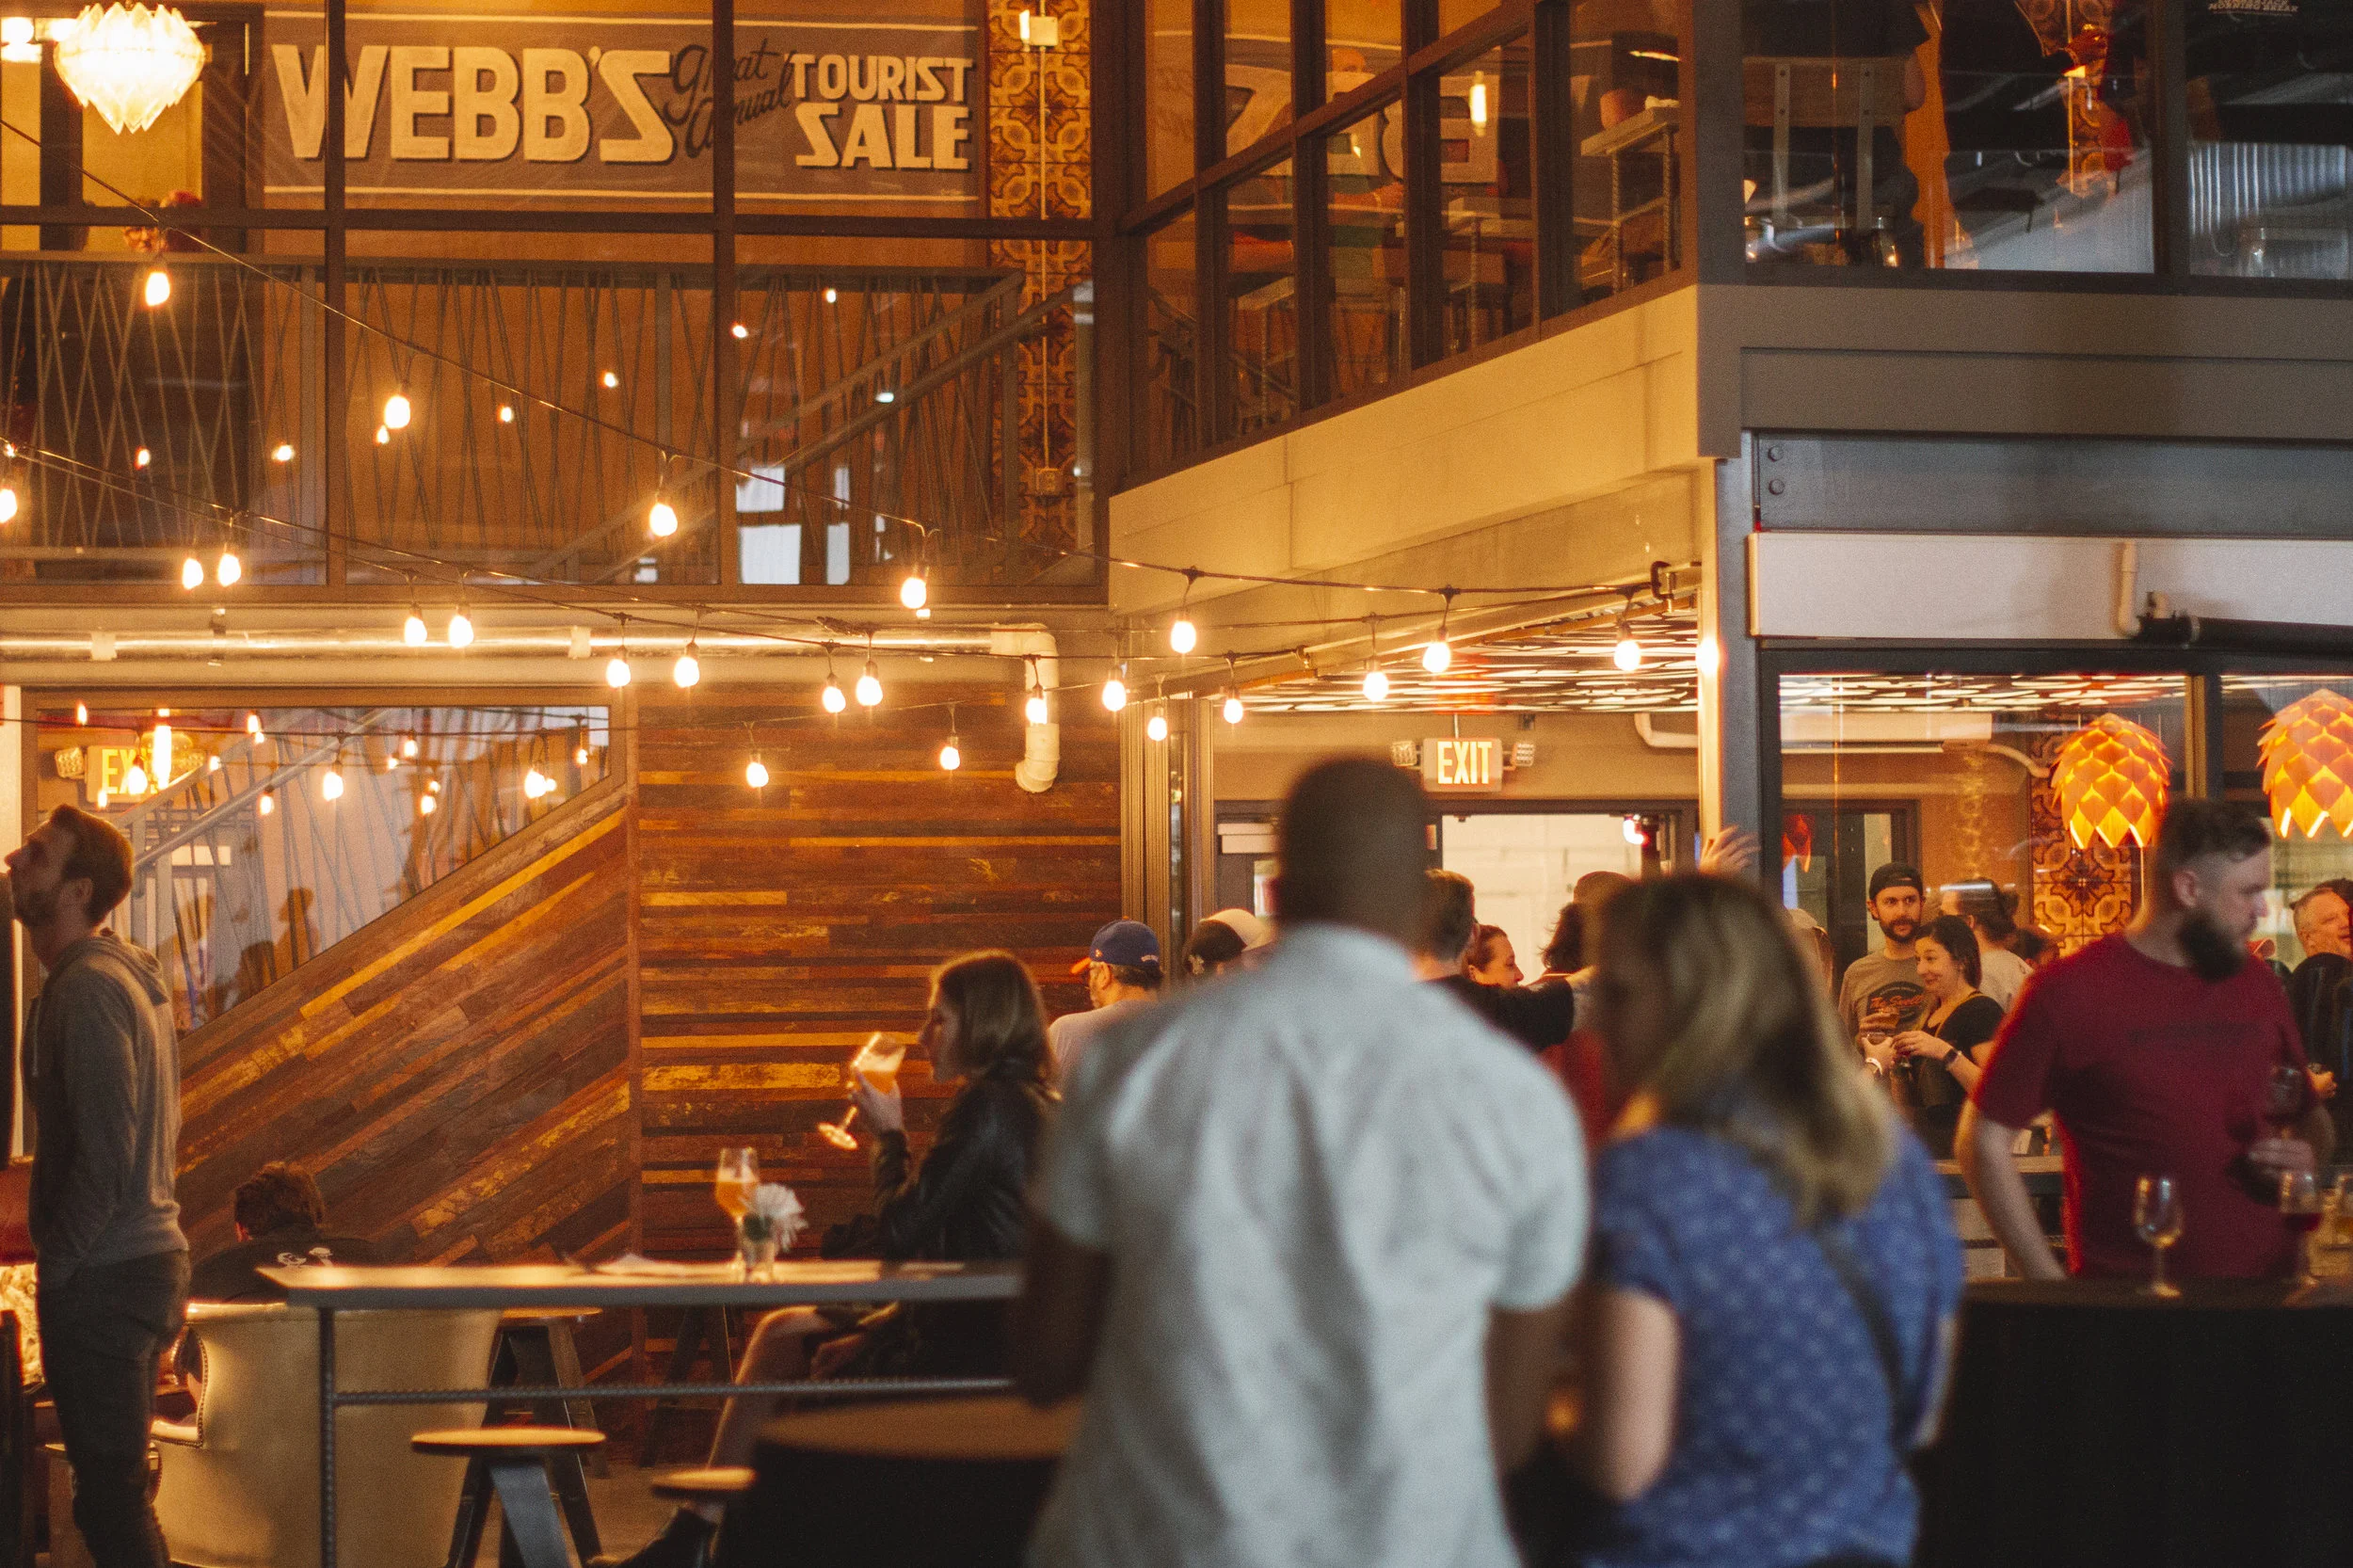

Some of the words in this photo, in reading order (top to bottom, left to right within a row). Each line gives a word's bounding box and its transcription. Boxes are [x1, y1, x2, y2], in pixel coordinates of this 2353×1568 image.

[785, 53, 973, 103] TOURIST
[270, 43, 672, 164] WEBB'S
[794, 101, 969, 170] SALE
[102, 748, 162, 794] EX
[1437, 741, 1493, 784] EXIT
